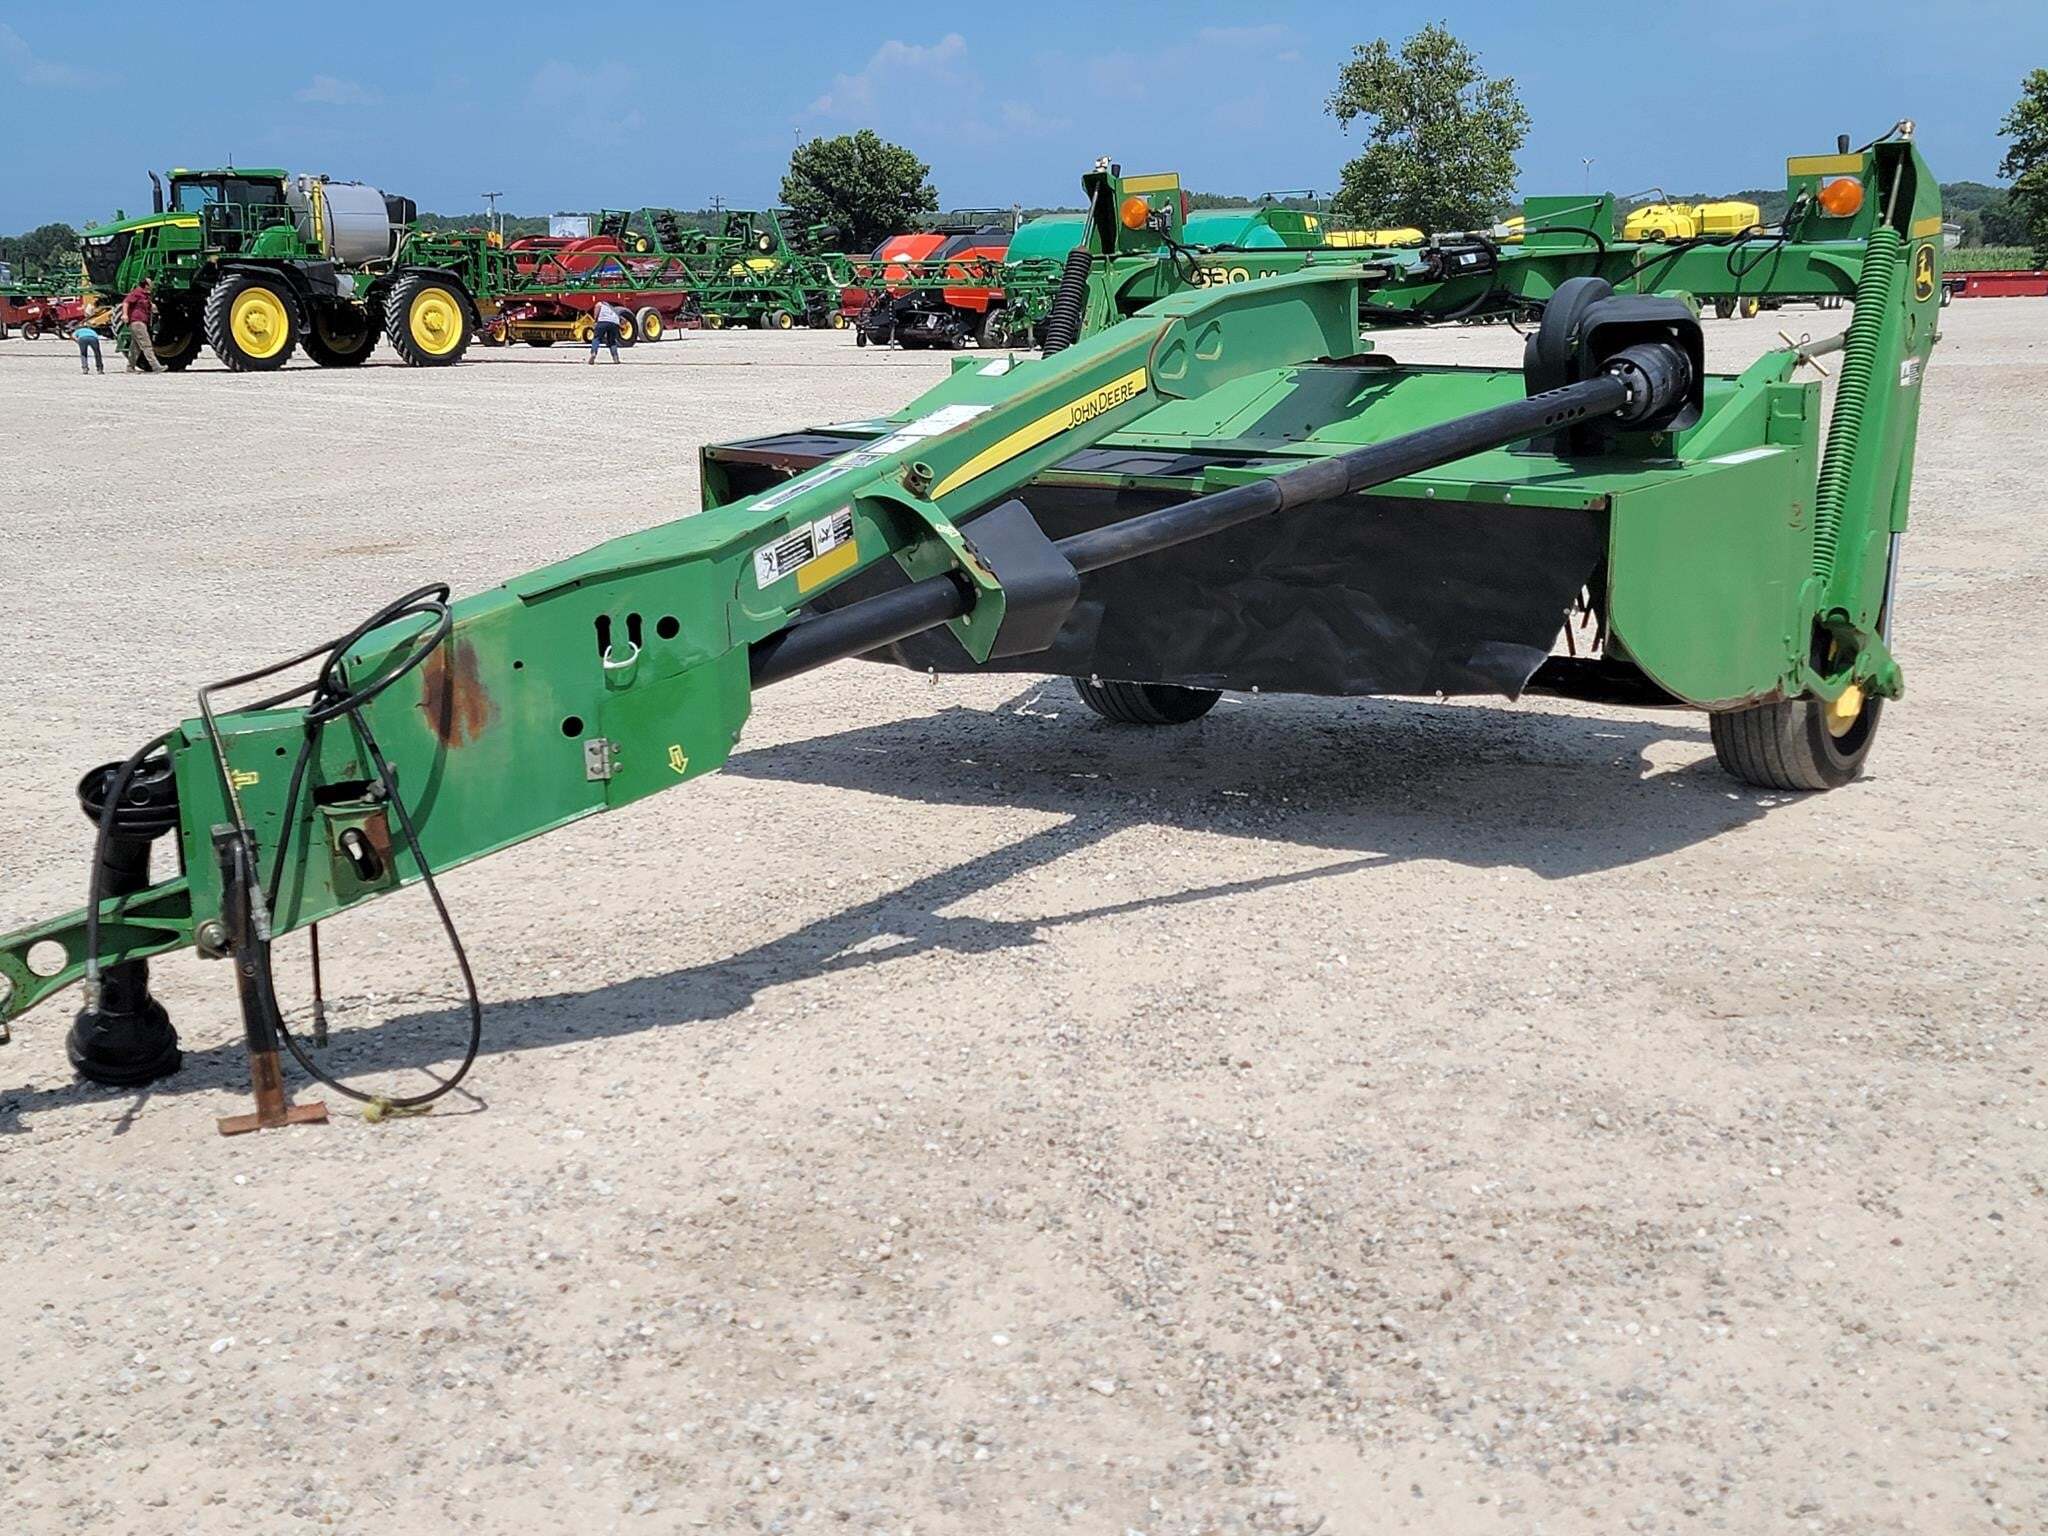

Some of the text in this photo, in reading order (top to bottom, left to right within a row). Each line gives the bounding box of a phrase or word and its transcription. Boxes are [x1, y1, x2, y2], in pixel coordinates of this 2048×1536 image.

[1191, 266, 1250, 289] 630
[1068, 381, 1135, 427] JOHN DEERE
